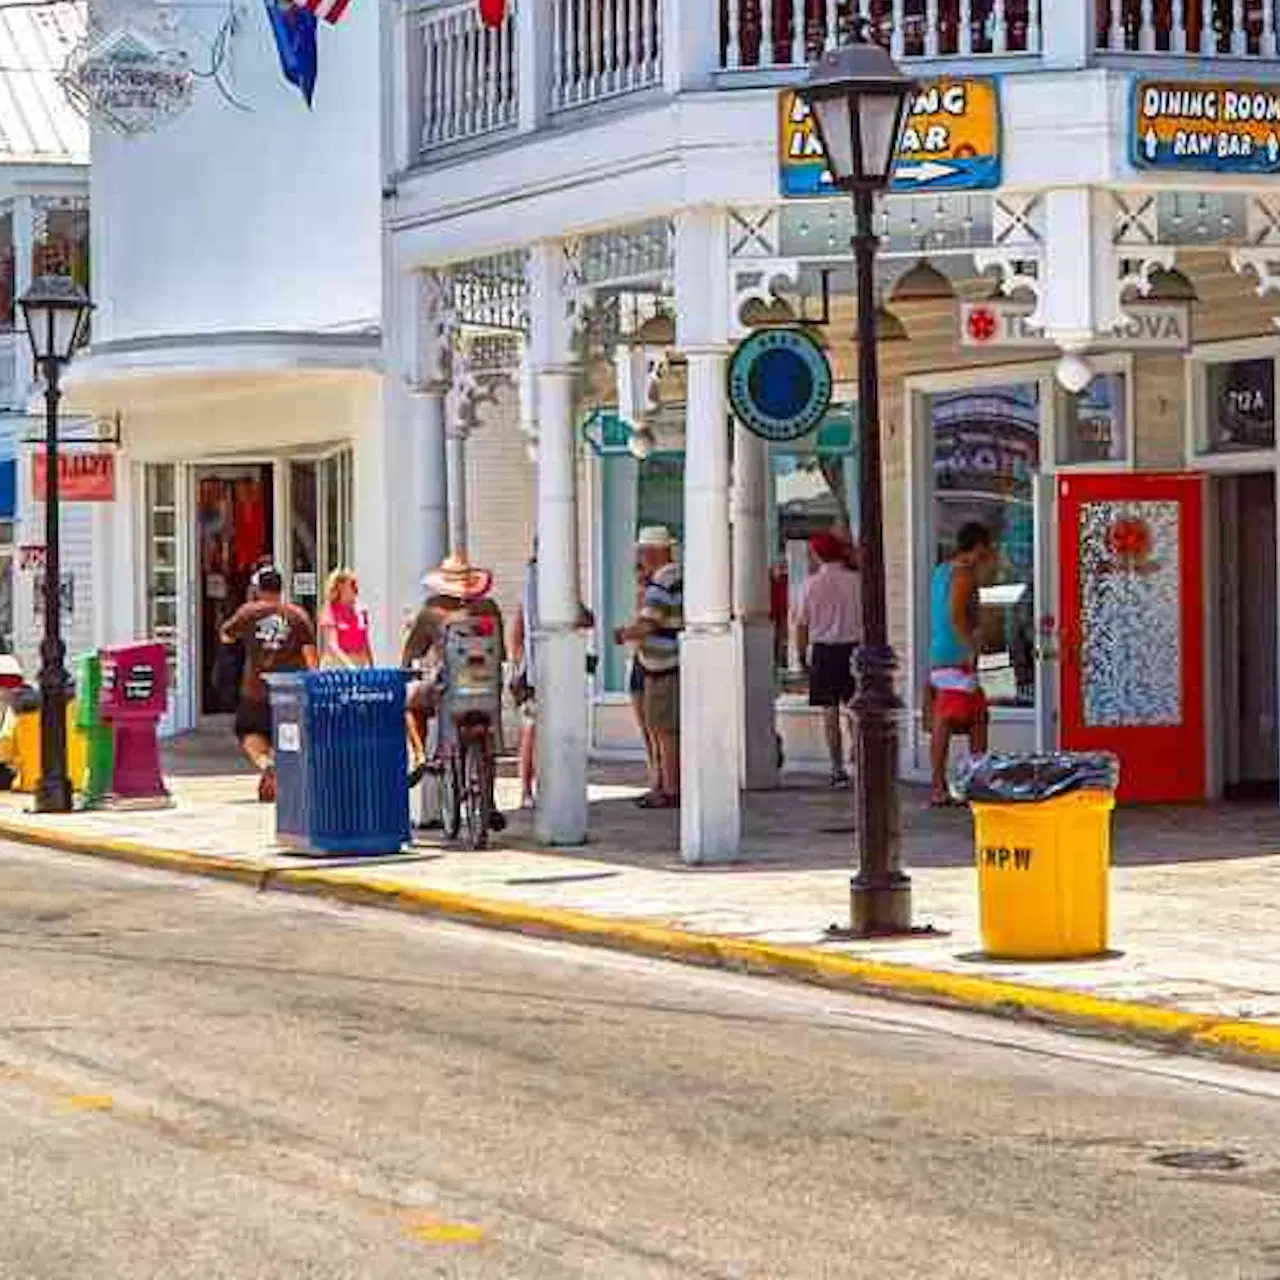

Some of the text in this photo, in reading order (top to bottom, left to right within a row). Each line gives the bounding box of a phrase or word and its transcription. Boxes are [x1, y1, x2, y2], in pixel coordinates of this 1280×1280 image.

[1144, 88, 1217, 119] DINING
[1174, 130, 1252, 157] RAW BAR
